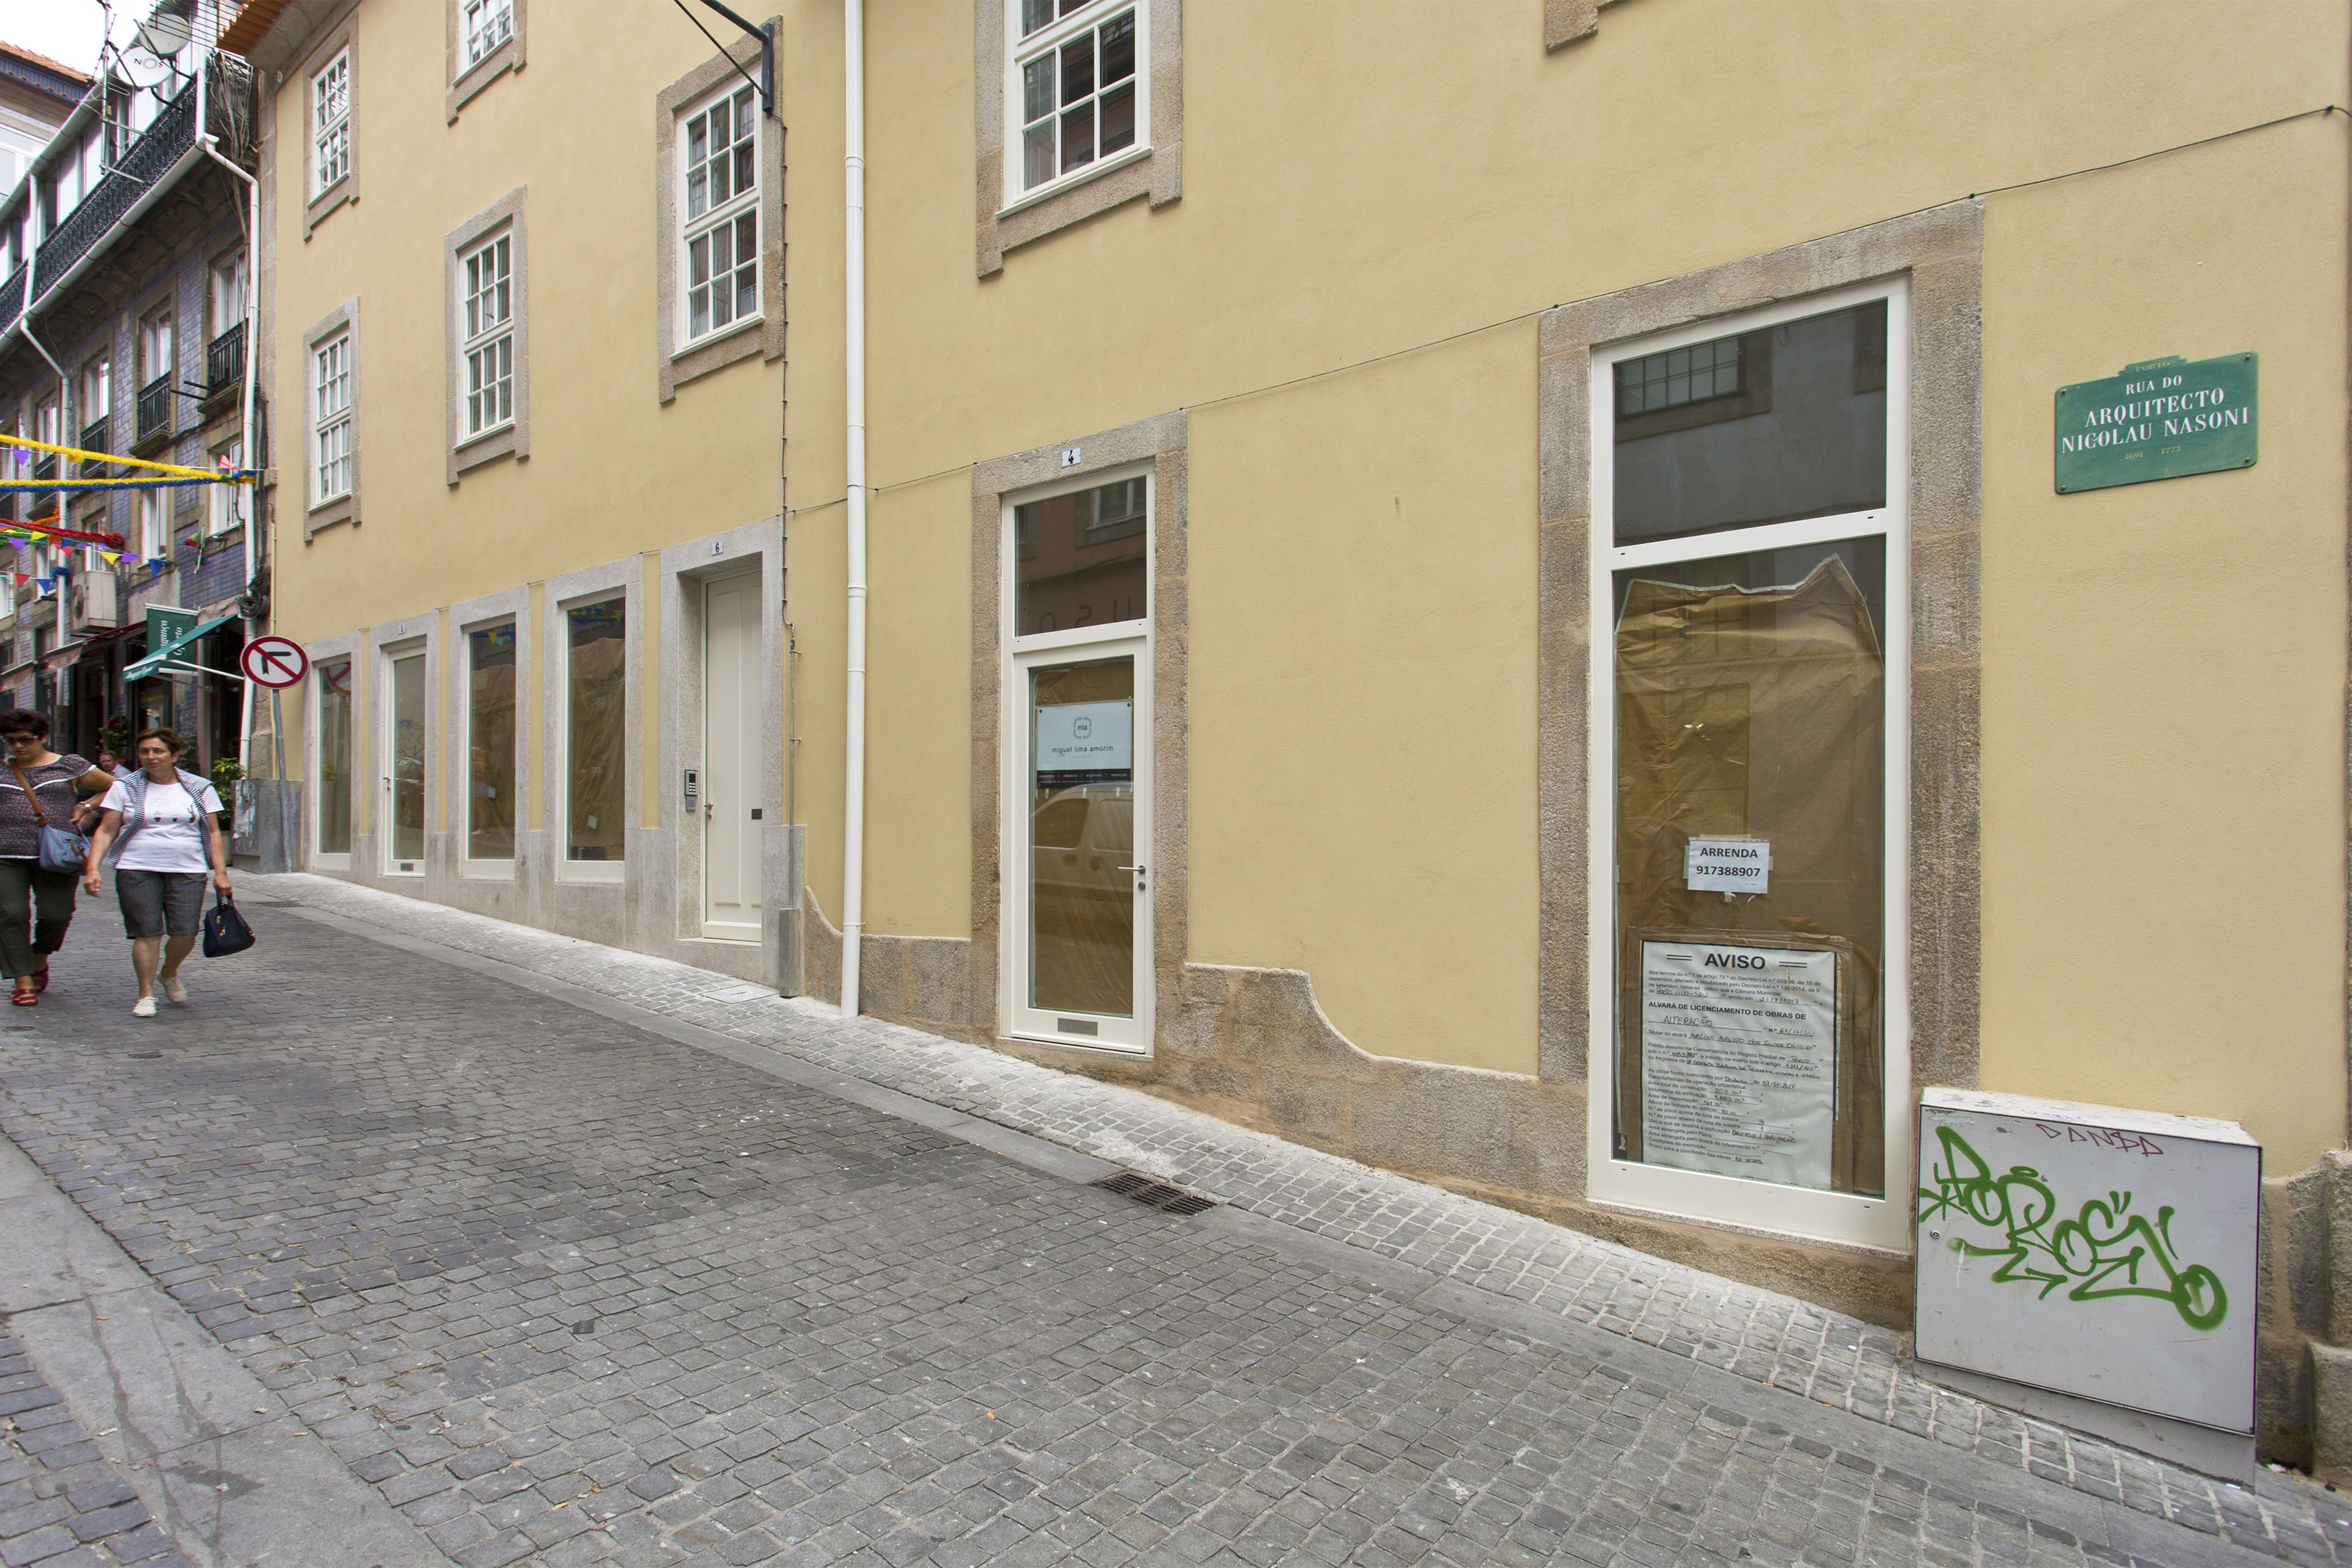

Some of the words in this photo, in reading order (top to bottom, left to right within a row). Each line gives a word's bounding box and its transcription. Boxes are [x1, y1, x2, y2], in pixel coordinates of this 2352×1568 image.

[134, 58, 163, 69] NOS
[2136, 360, 2171, 372] PORTO
[2126, 380, 2155, 395] RUA
[2162, 375, 2182, 388] DO
[2085, 387, 2225, 427] ARQUITECTO
[2062, 423, 2152, 453] NICOLAU
[2164, 407, 2249, 437] NASONI
[1068, 450, 1074, 464] 4
[2125, 451, 2144, 460] 1691
[2160, 445, 2182, 454] 1773
[715, 542, 719, 553] 6
[1700, 848, 1758, 858] ARRENDA
[1697, 865, 1760, 876] 917388907
[1705, 953, 1765, 970] AVISO
[1691, 1005, 1751, 1014] LICENCIAMENTO
[1664, 1016, 1712, 1027] ALTERAÇÃO
